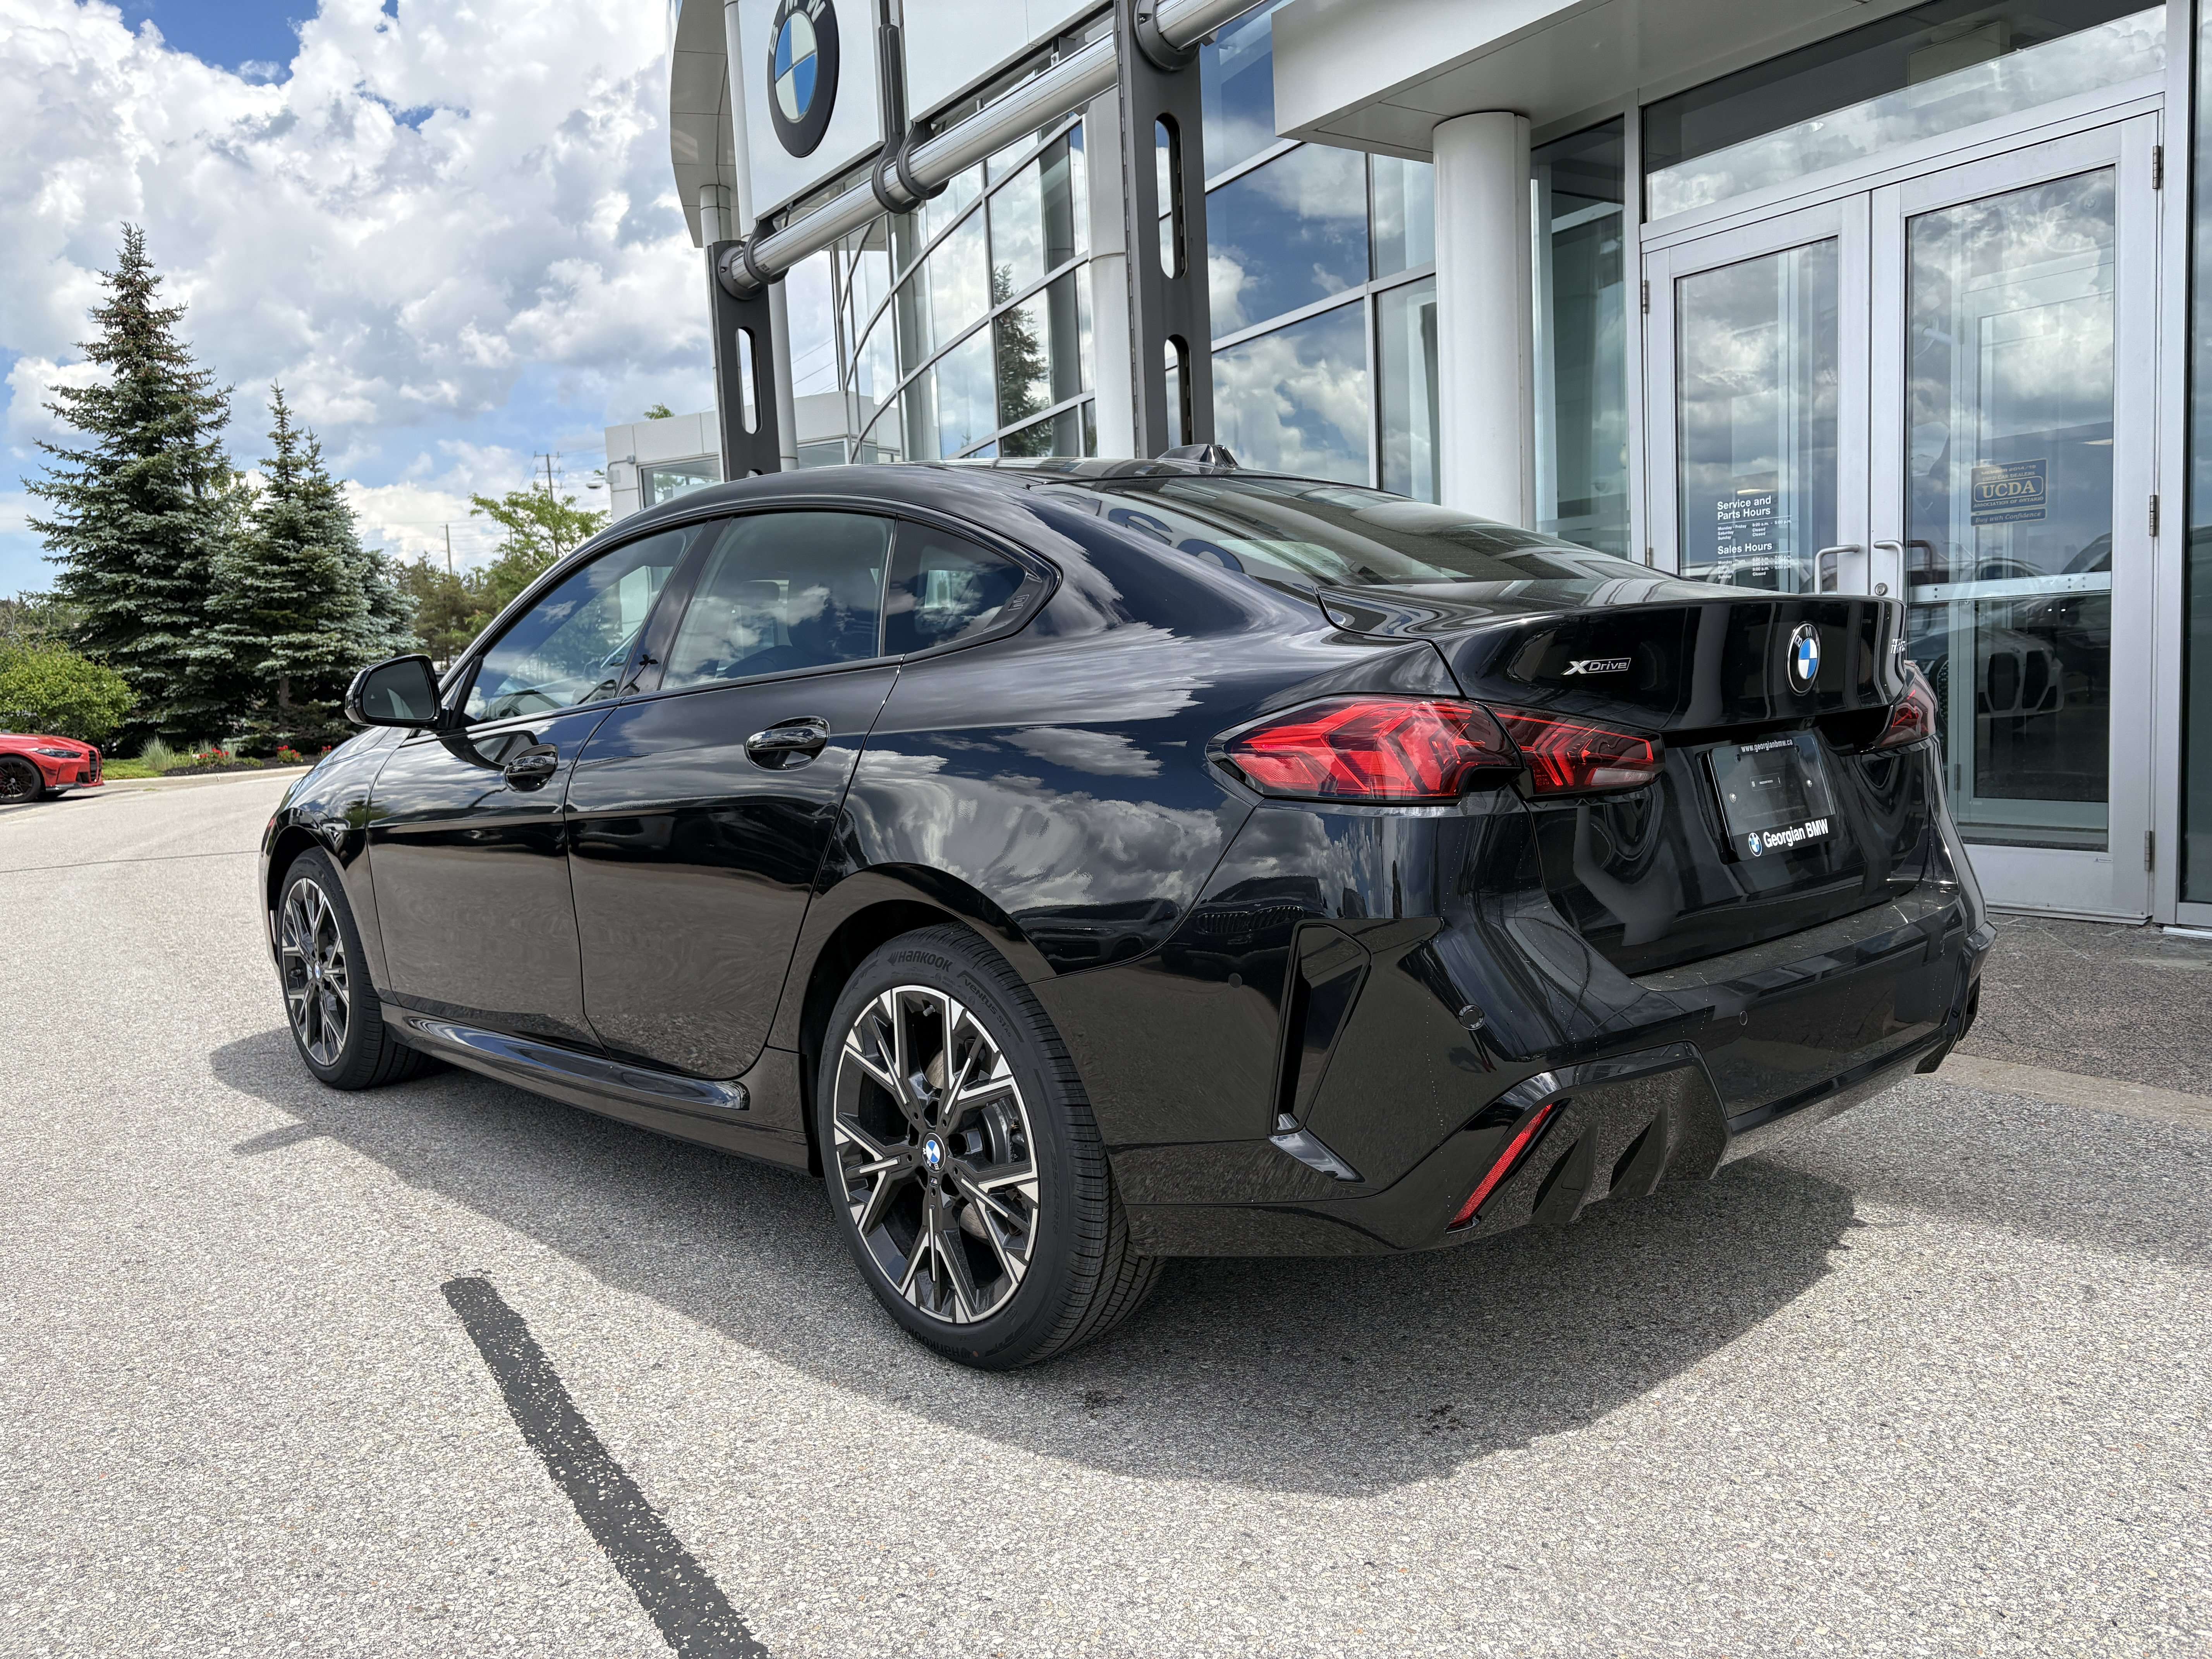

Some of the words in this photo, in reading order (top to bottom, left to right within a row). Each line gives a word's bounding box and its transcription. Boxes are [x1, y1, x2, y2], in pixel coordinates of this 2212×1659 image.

[1981, 480, 2036, 498] UCDA
[1717, 499, 1751, 510] Service
[1753, 495, 1771, 506] and
[1973, 500, 2008, 508] ASSOCIATION
[1717, 510, 1741, 520] Parts
[1743, 507, 1771, 517] Hours
[2005, 512, 2042, 520] Confidence
[1717, 545, 1742, 555] Sales
[1745, 543, 1772, 552] Hours
[1741, 739, 1793, 752] www.georgianbmw.ca
[1763, 826, 1806, 848] Georgian
[1805, 818, 1829, 838] BMW
